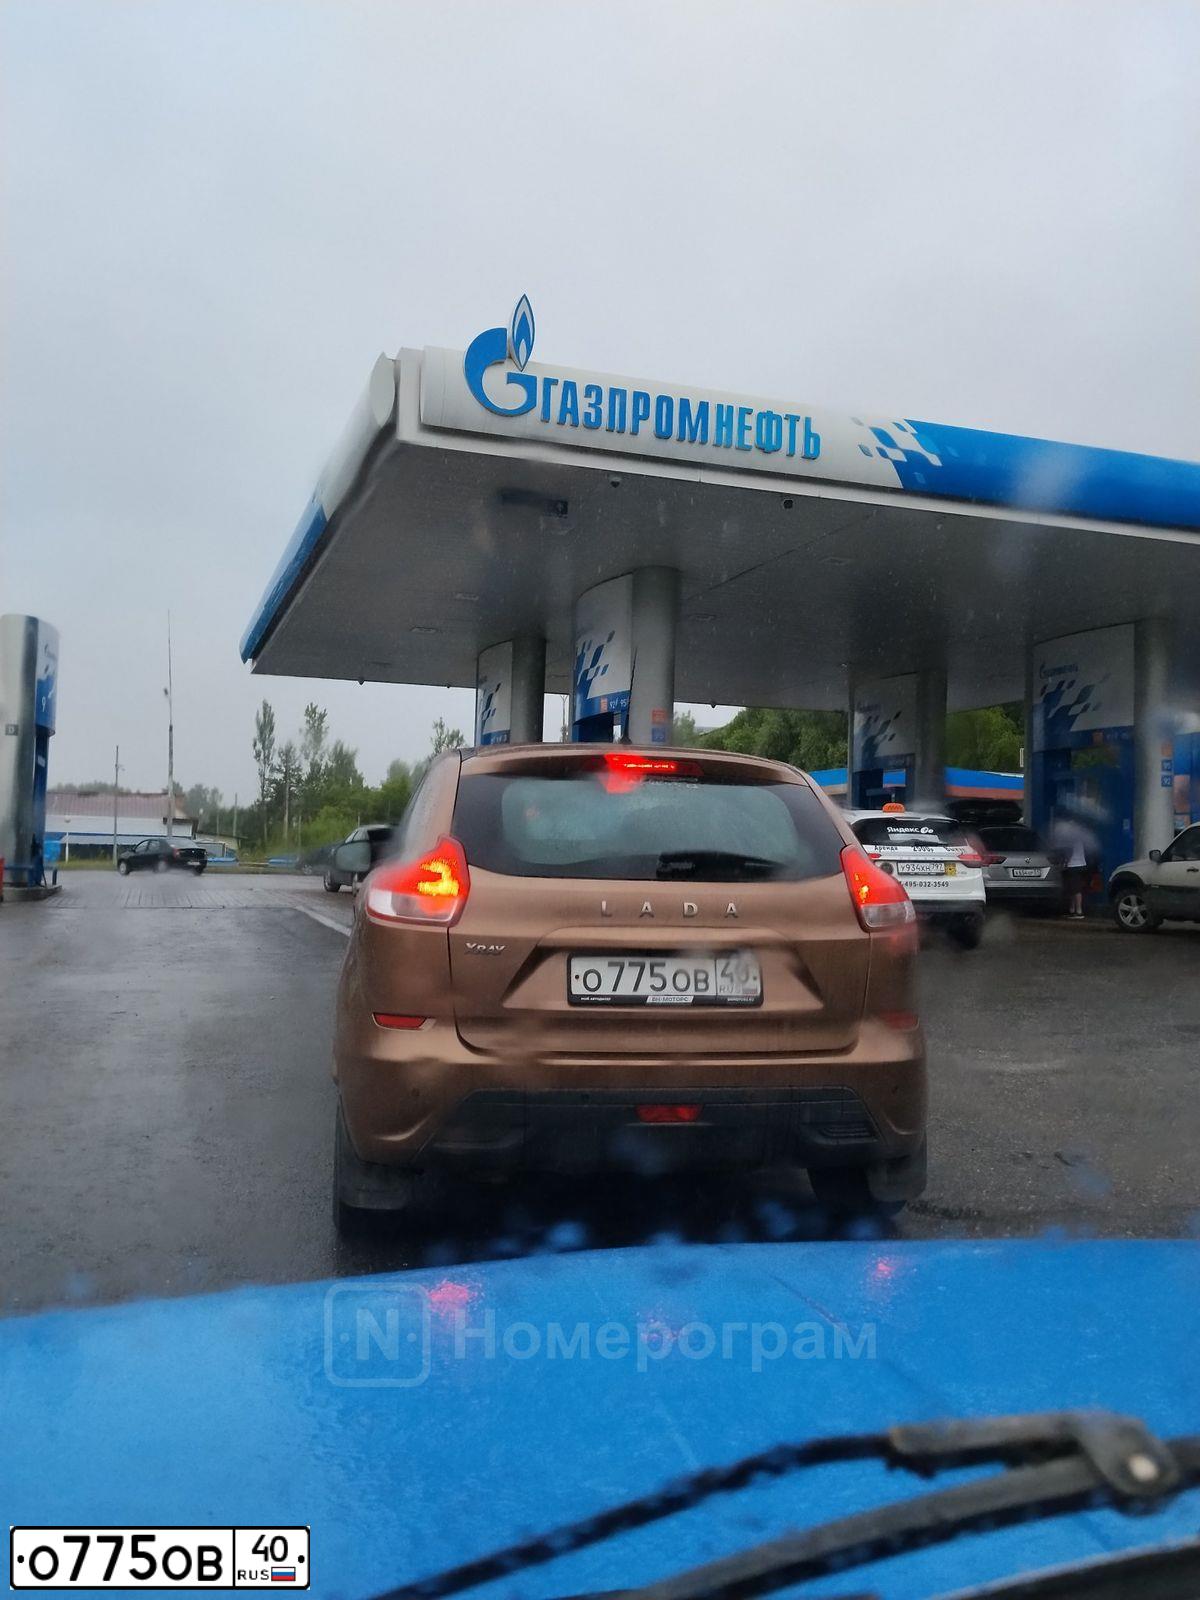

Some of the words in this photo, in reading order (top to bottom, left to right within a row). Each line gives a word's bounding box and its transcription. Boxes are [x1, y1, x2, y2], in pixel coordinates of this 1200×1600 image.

[540, 376, 821, 460] ГАЗПРОМНЕФТЬ
[601, 900, 739, 918] LADA
[582, 961, 710, 992] О775ОВ
